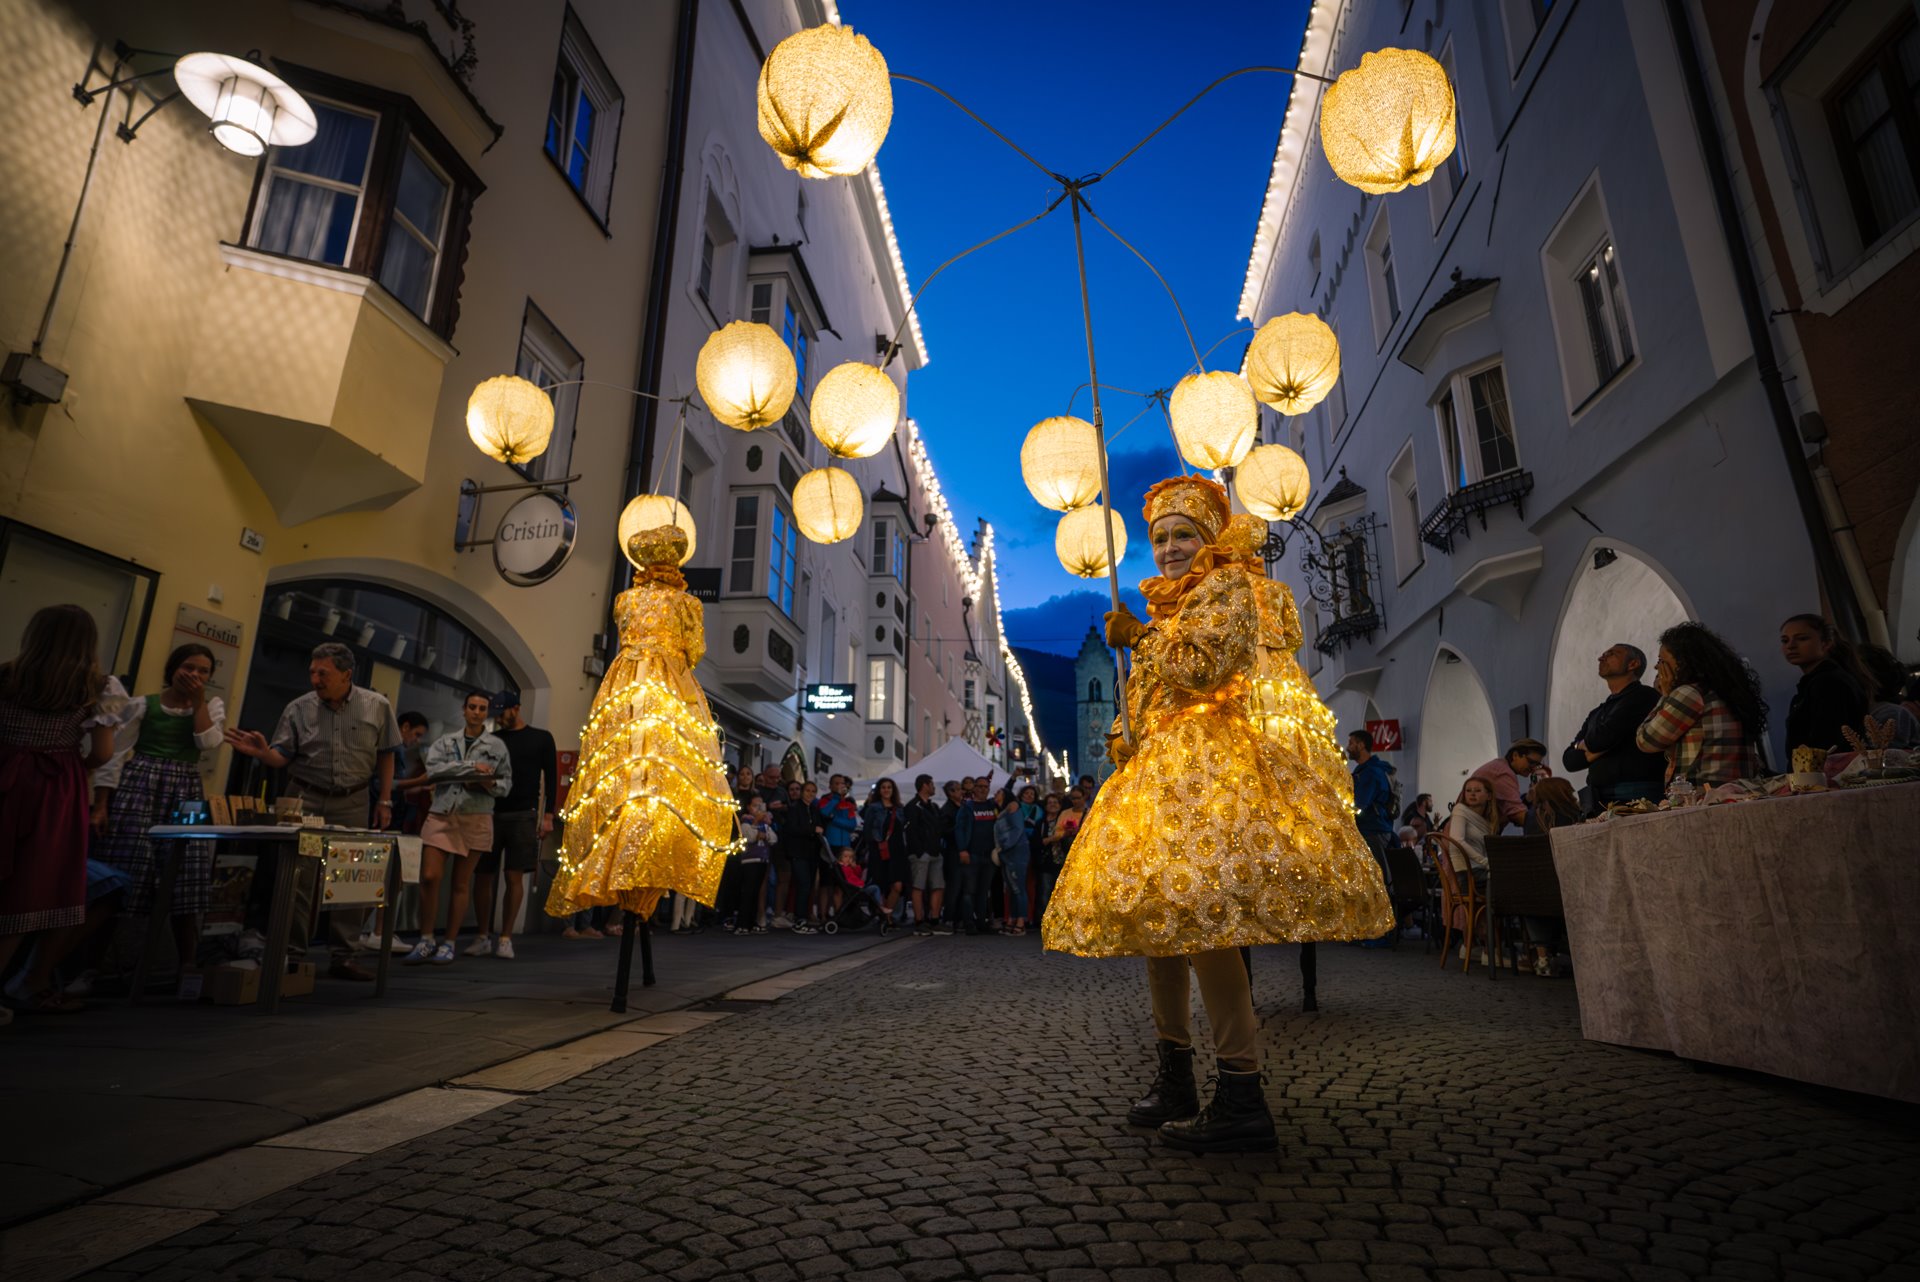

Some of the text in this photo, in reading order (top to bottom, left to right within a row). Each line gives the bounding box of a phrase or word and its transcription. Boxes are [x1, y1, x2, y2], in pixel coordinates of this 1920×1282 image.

[501, 519, 559, 542] Cristin
[196, 620, 239, 644] Cristin
[1372, 723, 1399, 752] illy
